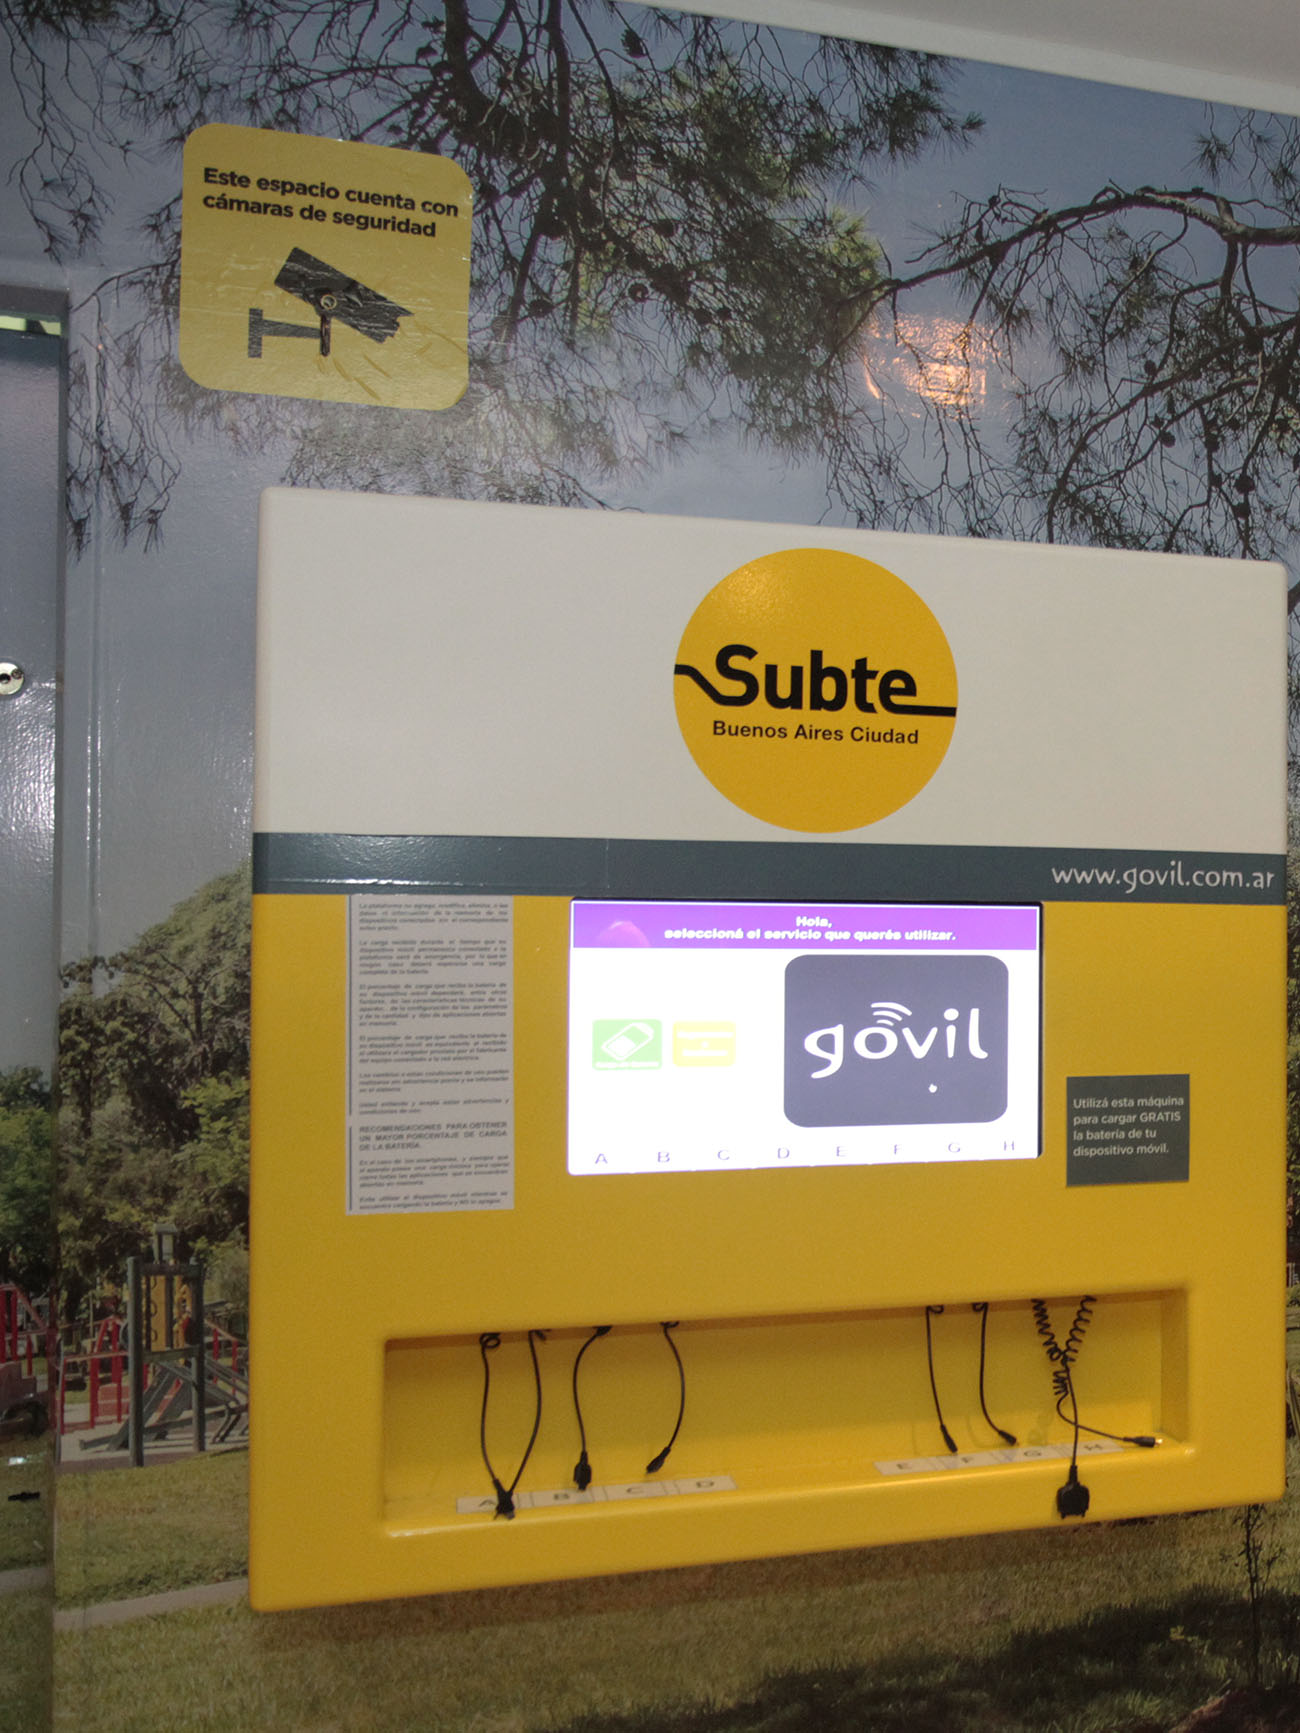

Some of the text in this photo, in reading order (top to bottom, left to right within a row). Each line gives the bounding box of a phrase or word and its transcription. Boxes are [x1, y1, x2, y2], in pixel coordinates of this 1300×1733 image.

[203, 167, 459, 217] Este espacio cuenta con
[203, 193, 437, 238] cámaras de seguridad
[674, 643, 957, 718] Subte
[712, 720, 919, 745] Buenos Aires Ciudad
[1052, 860, 1275, 894] www.govil.com.ar
[746, 928, 761, 940] el
[764, 928, 821, 941] servicio
[825, 930, 851, 943] que
[853, 929, 901, 943] querés
[804, 1007, 989, 1080] govil
[1073, 1095, 1184, 1110] Utilizá esta máquina
[1073, 1111, 1181, 1126] para cargar GRATIS
[1073, 1128, 1157, 1141] la batería de tu
[594, 1152, 608, 1166] A
[657, 1151, 671, 1163] B
[717, 1149, 731, 1162] C
[776, 1147, 790, 1160] D
[836, 1146, 847, 1158] E
[948, 1142, 962, 1154] G
[1003, 1140, 1016, 1152] H
[1073, 1142, 1169, 1158] dispositivo móvil.
